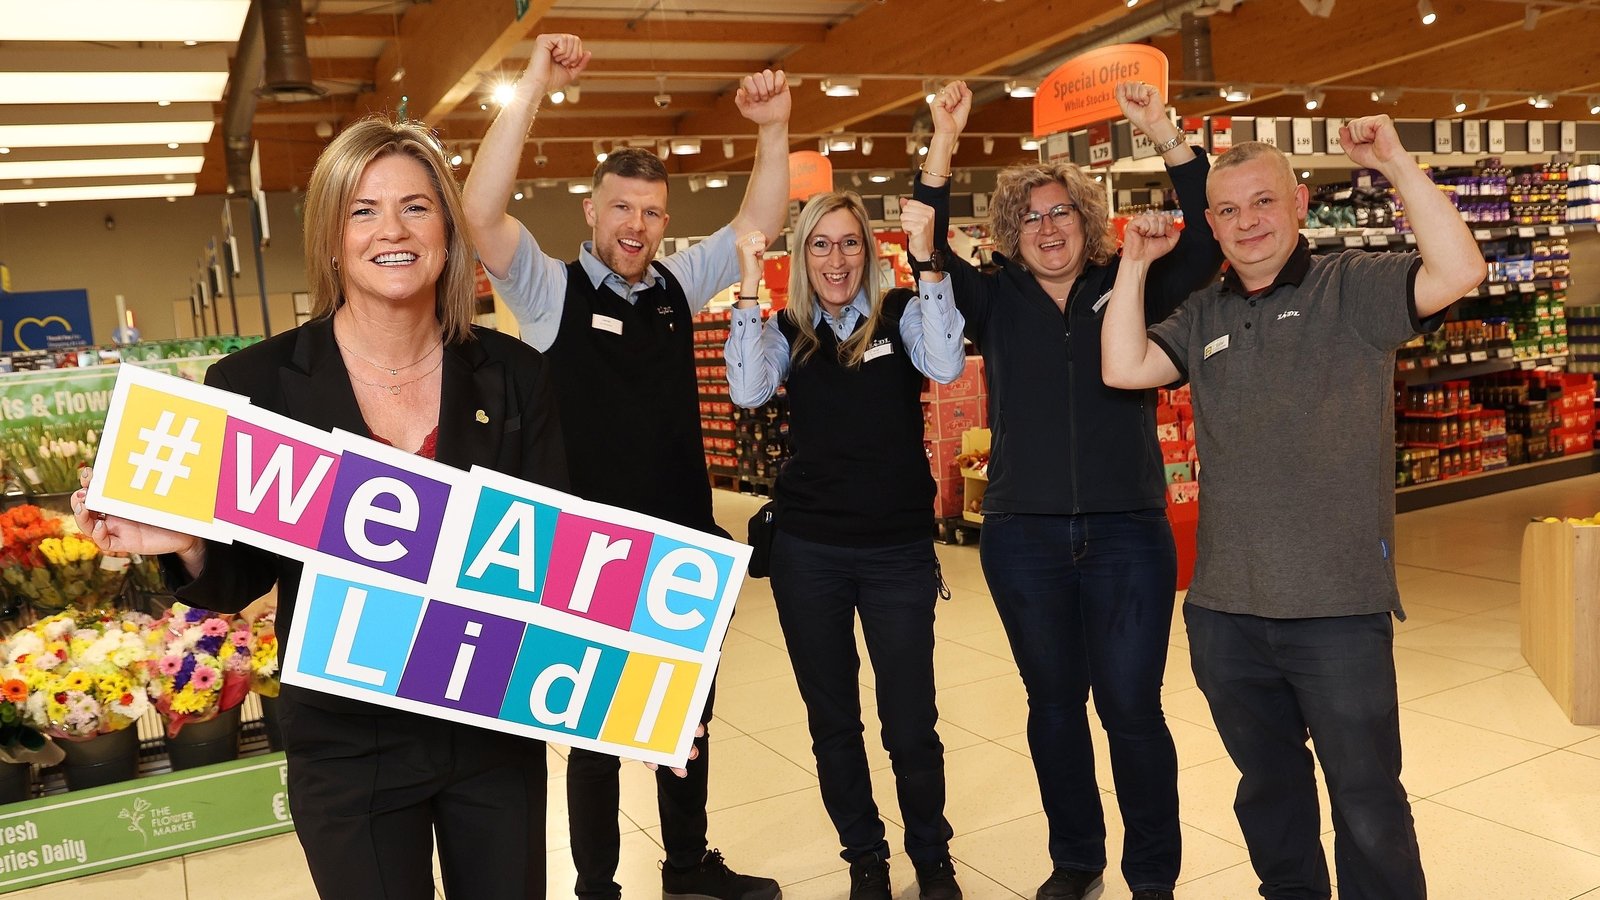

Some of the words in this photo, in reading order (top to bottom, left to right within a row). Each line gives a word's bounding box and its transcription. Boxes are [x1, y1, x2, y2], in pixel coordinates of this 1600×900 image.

[1054, 69, 1097, 101] Special
[1099, 61, 1140, 84] Offers
[1064, 98, 1085, 112] While
[1086, 91, 1110, 106] Stocks
[1093, 146, 1109, 159] 1.79
[31, 393, 52, 418] &
[54, 389, 114, 416] Flow
[325, 587, 673, 743] Lidl
[151, 806, 171, 818] THE
[151, 811, 194, 828] FLOWER
[153, 820, 197, 837] MARKET
[41, 838, 88, 863] Daily
